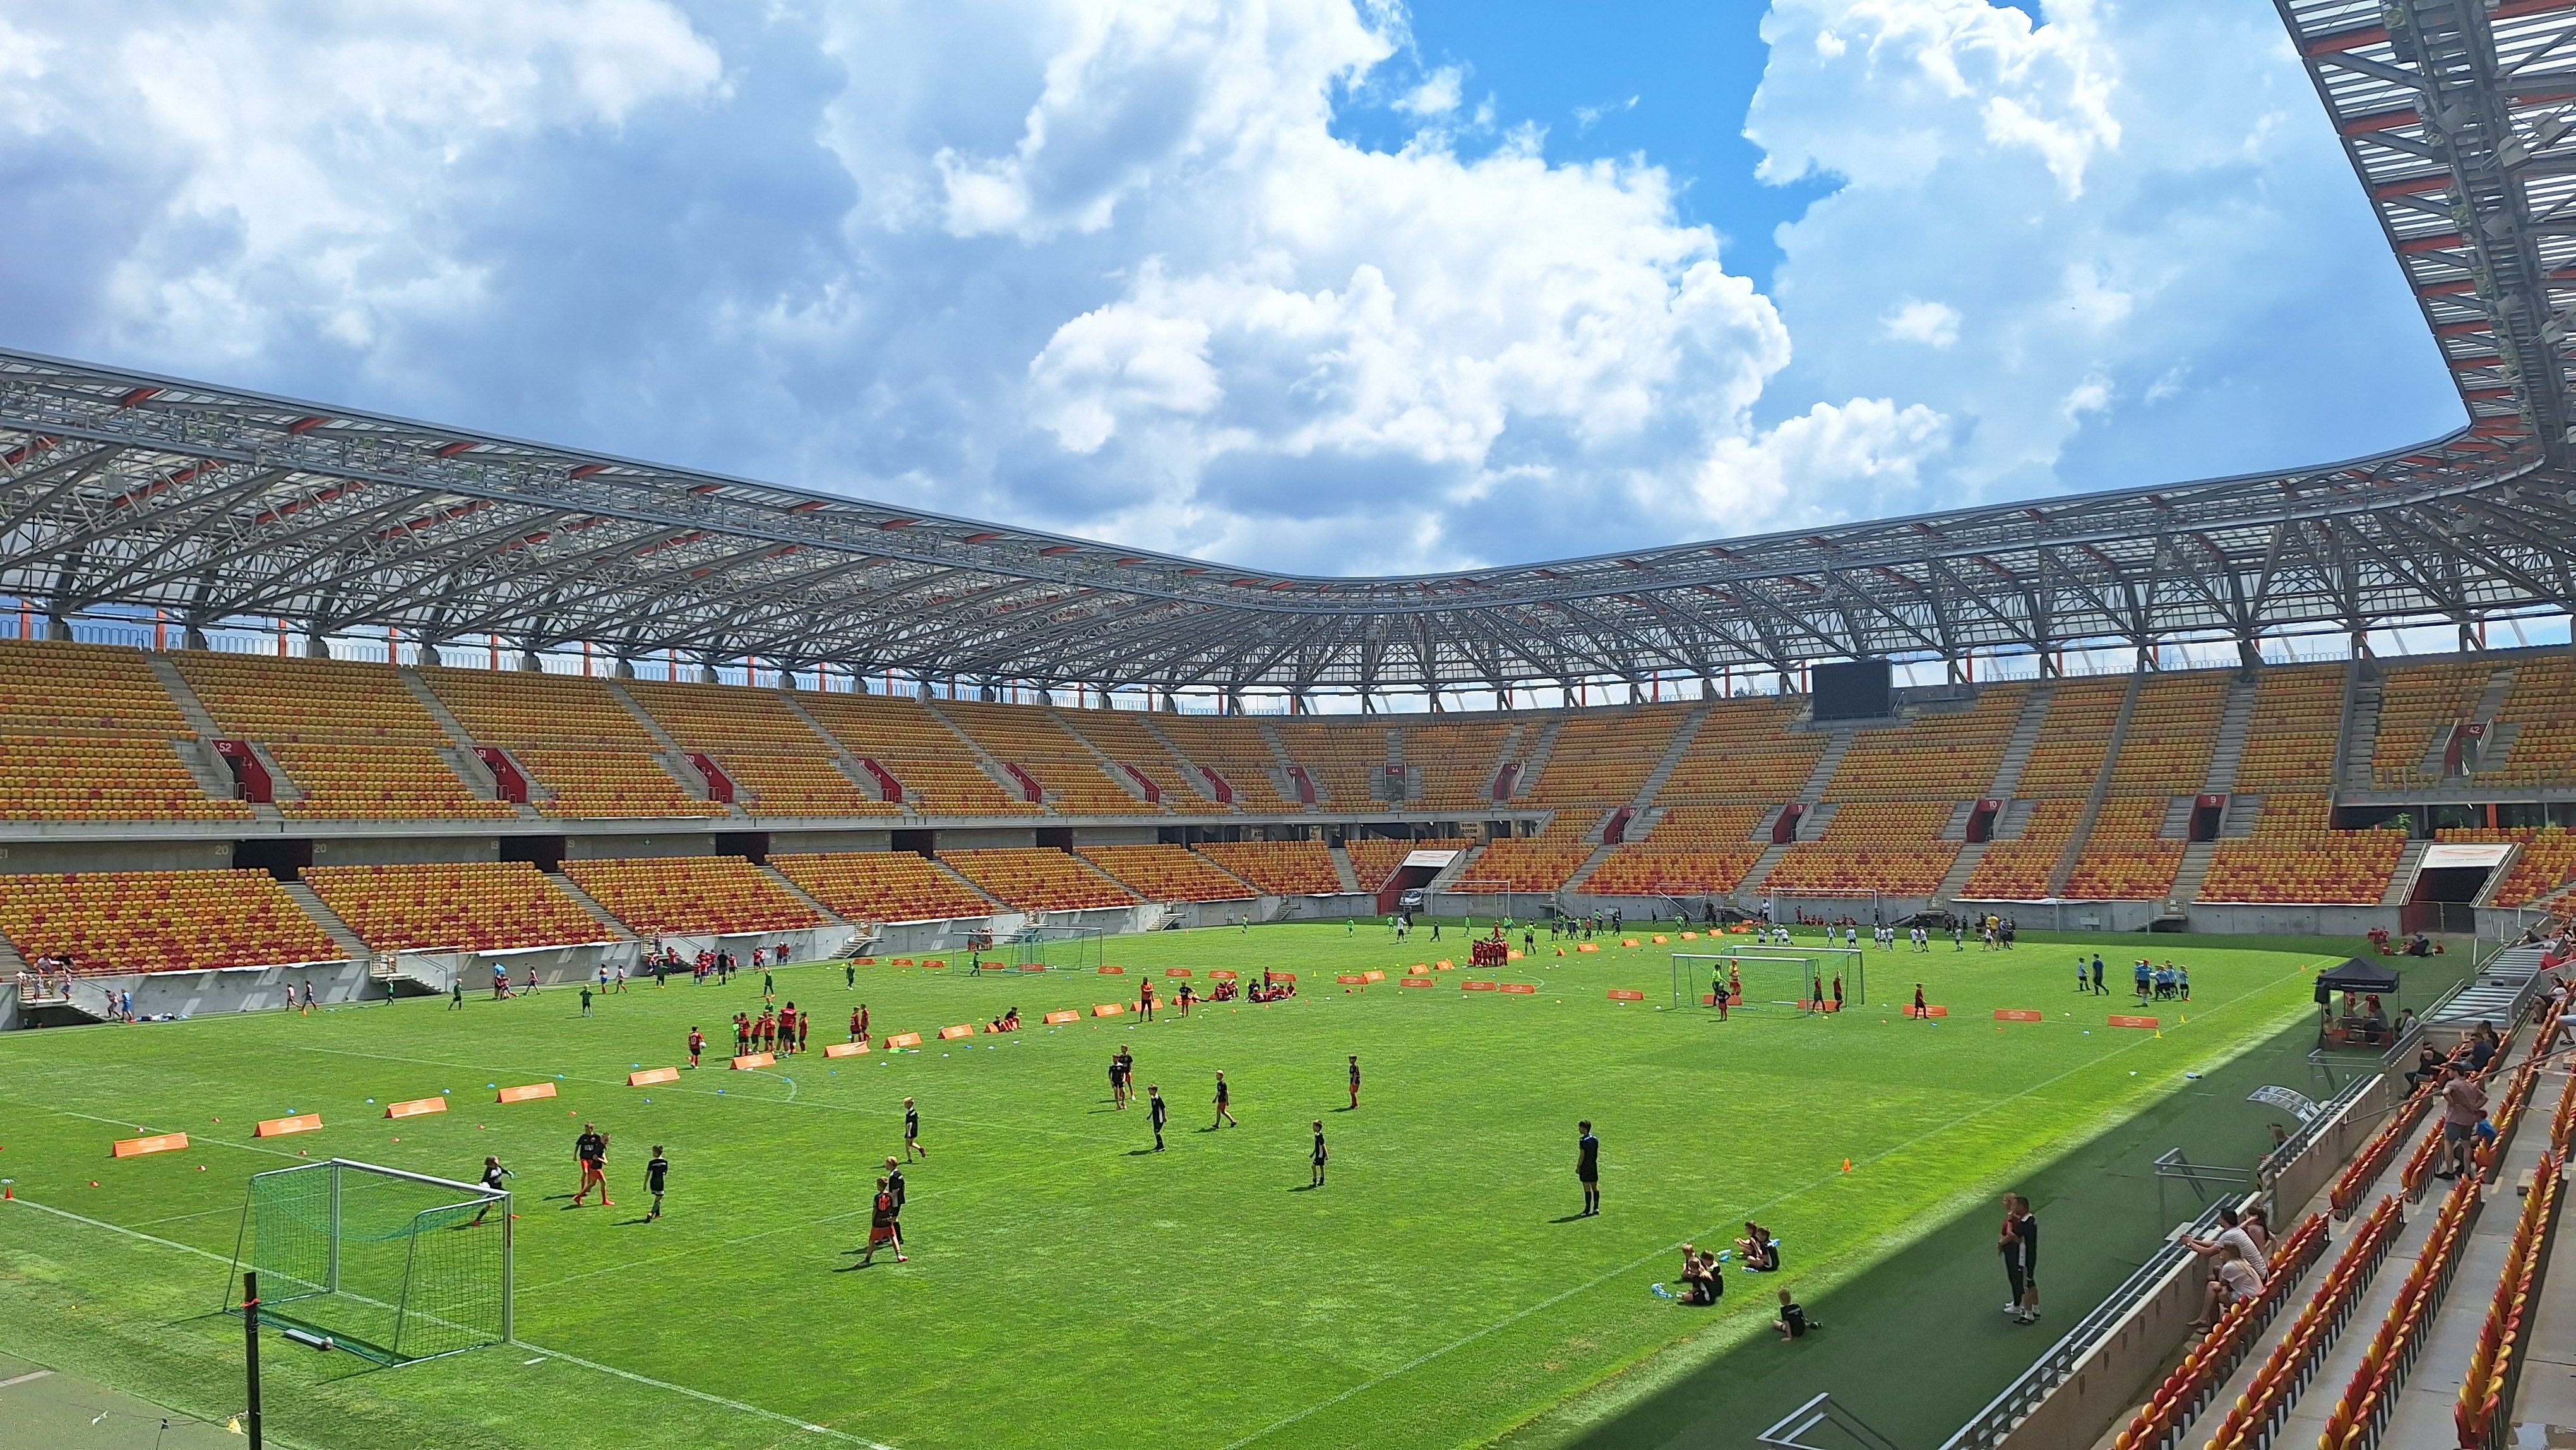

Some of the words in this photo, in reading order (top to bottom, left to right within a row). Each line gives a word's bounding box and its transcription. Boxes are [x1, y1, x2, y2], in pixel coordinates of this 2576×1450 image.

[2469, 726, 2480, 734] 42
[218, 742, 232, 753] 52
[478, 750, 486, 758] 51
[1798, 805, 1803, 813] 11
[1989, 800, 1998, 809] 10
[314, 843, 326, 853] 20
[491, 841, 499, 849] 19
[567, 839, 575, 848] 19
[215, 845, 228, 855] 20
[690, 1036, 697, 1045] 10
